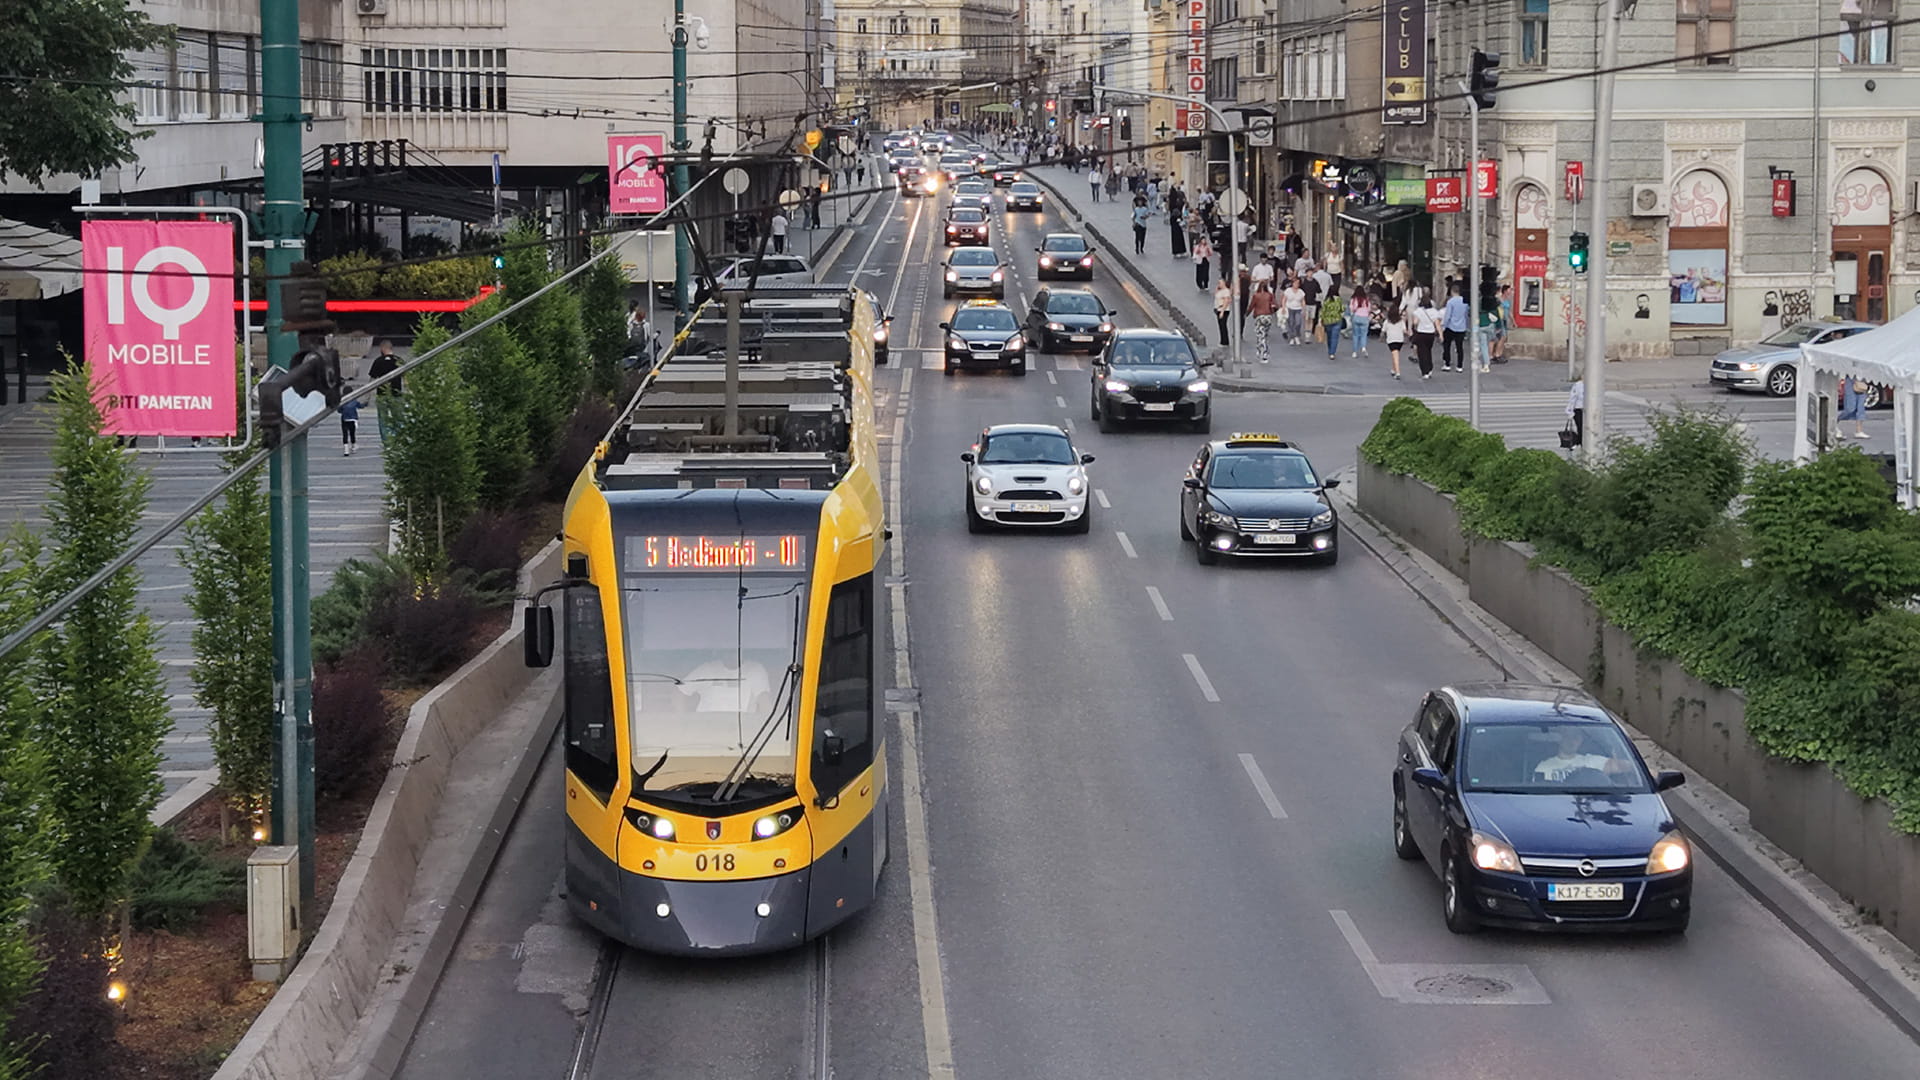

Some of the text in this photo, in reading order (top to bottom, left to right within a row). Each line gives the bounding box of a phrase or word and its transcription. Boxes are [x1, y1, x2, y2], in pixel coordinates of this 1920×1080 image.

[1398, 6, 1410, 69] CLUB
[617, 179, 656, 188] MOBILE
[106, 246, 210, 340] IQ
[108, 344, 210, 364] MOBILE
[696, 853, 735, 872] 018
[1557, 886, 1621, 898] K17-E-509
